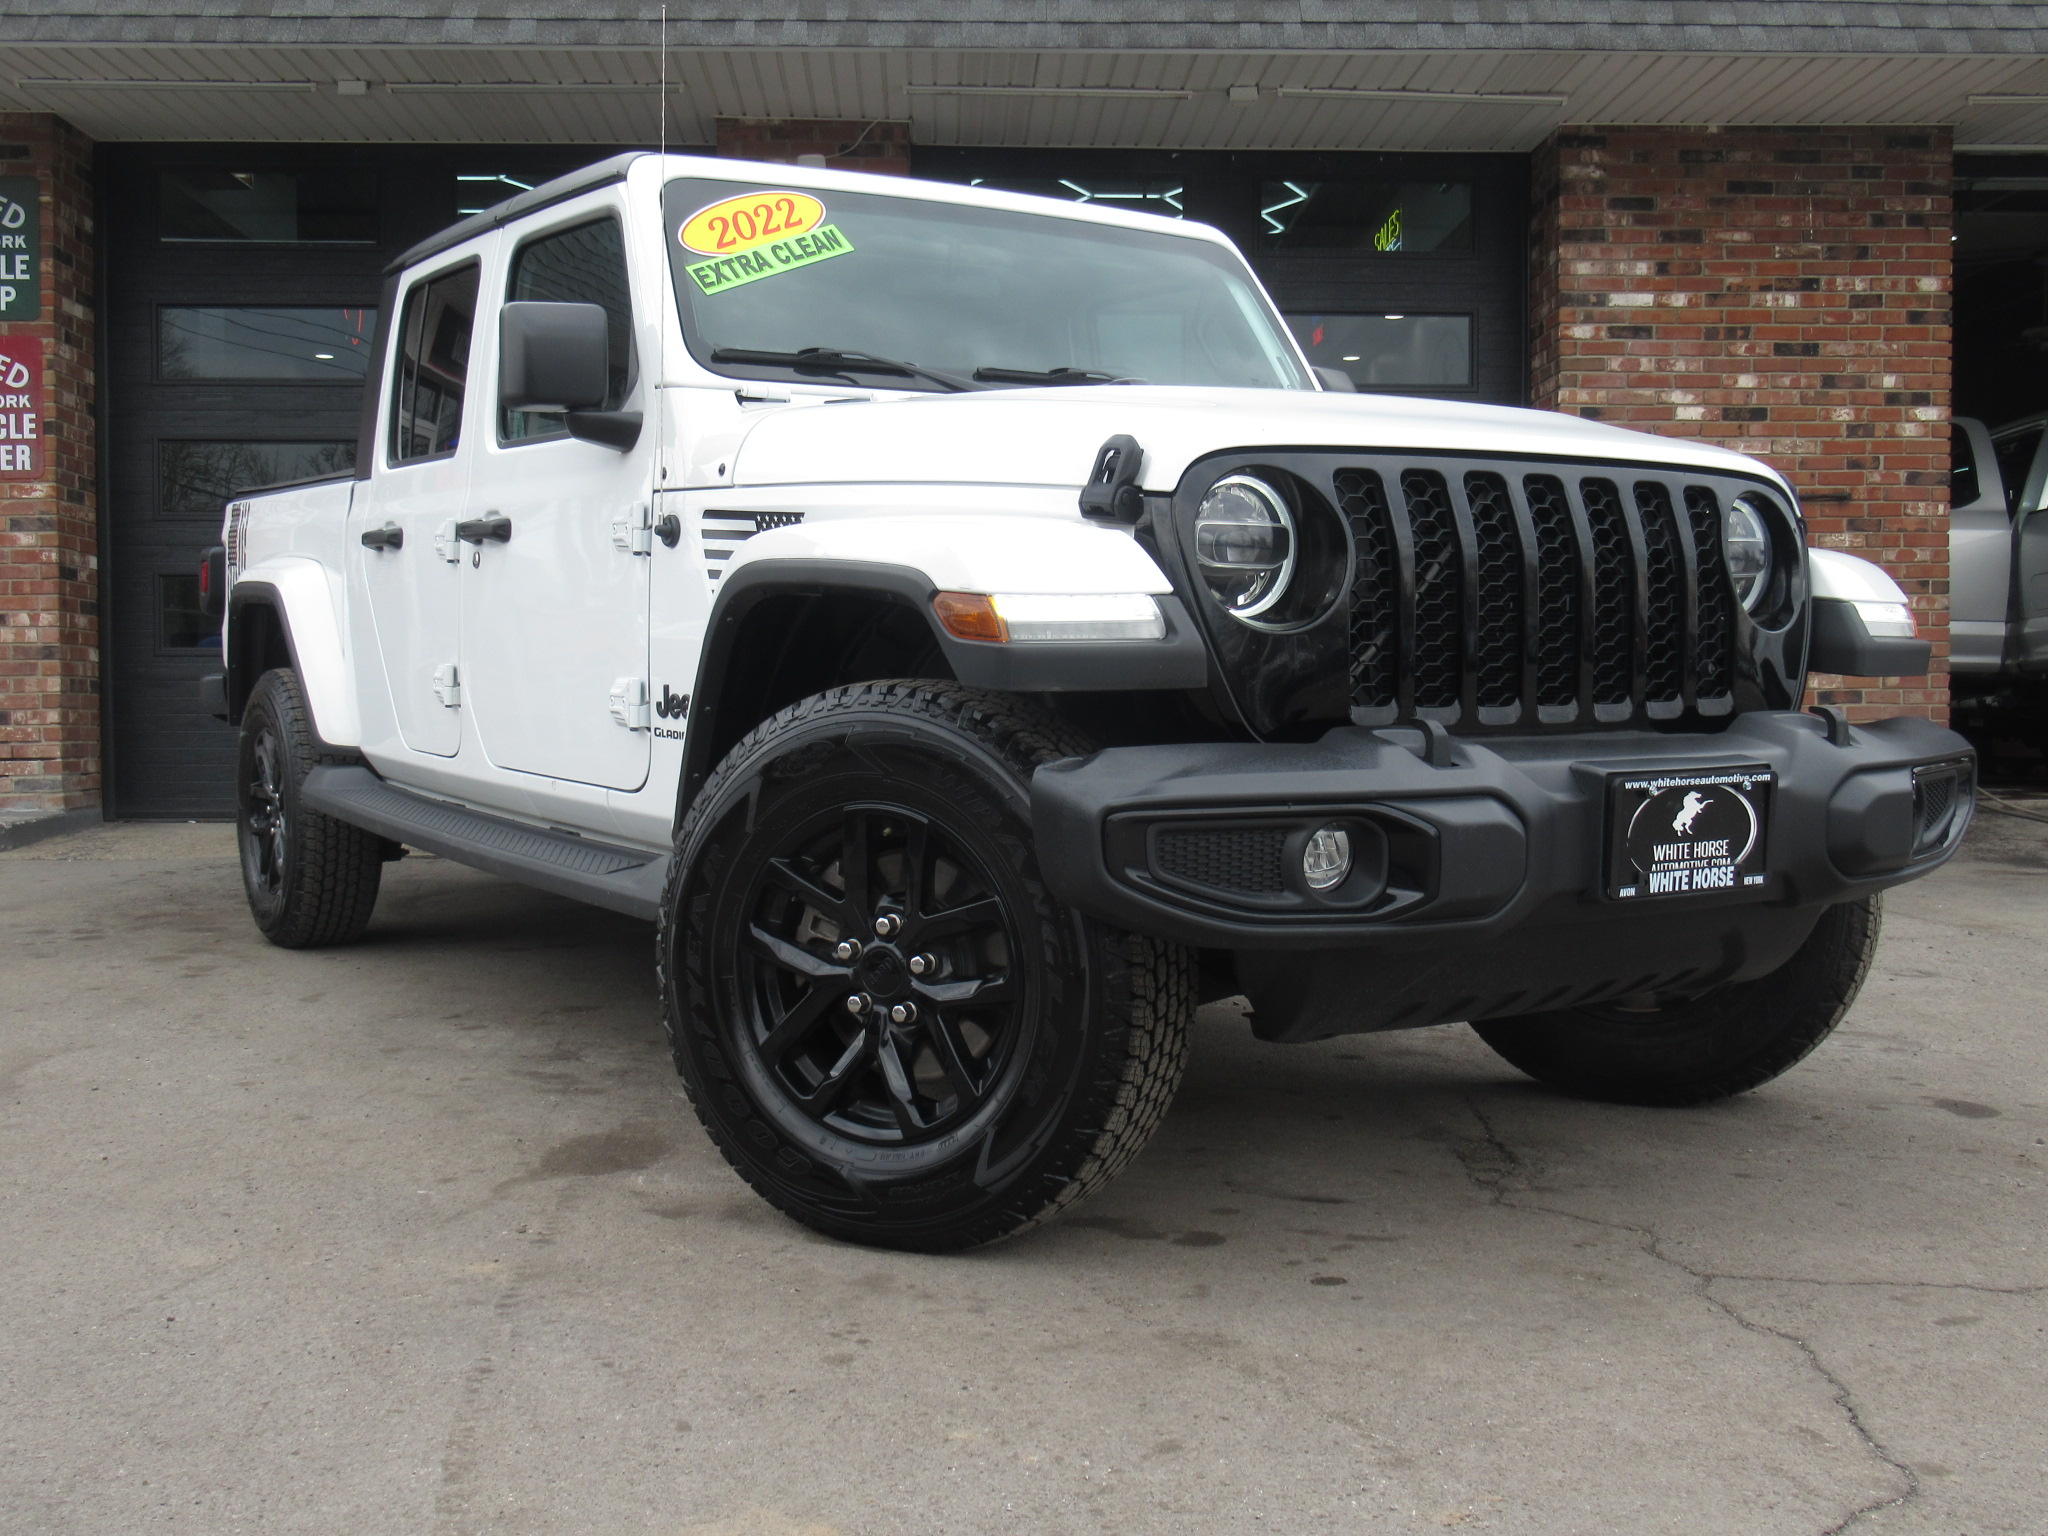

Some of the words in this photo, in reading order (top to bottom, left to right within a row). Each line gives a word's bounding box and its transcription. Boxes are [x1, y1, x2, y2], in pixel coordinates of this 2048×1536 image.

[708, 198, 803, 250] 2022
[692, 250, 774, 290] EXTRA
[770, 228, 843, 266] CLEAN
[654, 727, 685, 740] GLADI
[1624, 773, 1771, 790] www.whitehorseautomotive.com
[1653, 842, 1690, 861] WHITE
[1693, 839, 1730, 858] HORSE
[1649, 869, 1690, 894] WHITE
[1692, 865, 1735, 890] HORSE
[1619, 886, 1636, 898] AVON
